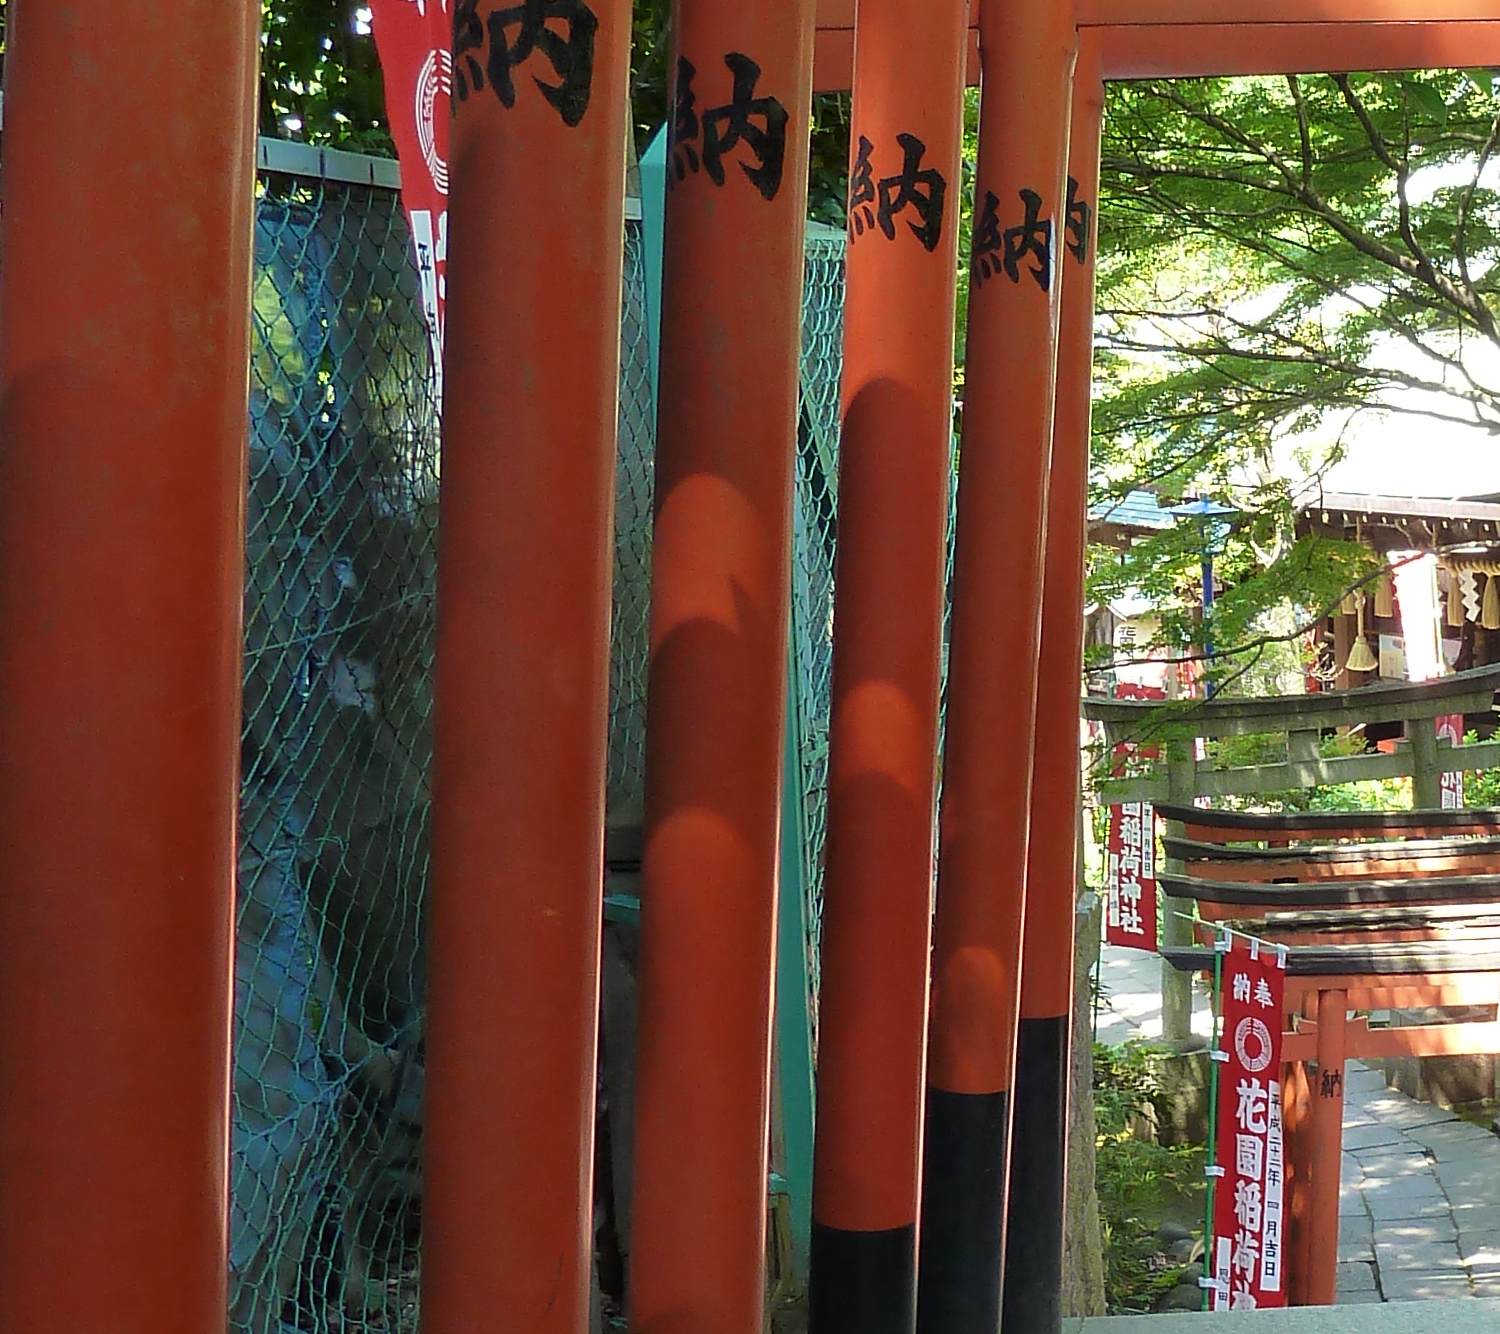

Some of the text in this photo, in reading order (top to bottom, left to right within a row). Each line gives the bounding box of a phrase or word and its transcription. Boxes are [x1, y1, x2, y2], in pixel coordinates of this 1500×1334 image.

[669, 51, 789, 201] 納
[848, 132, 946, 253] 納
[972, 188, 1054, 291] 納
